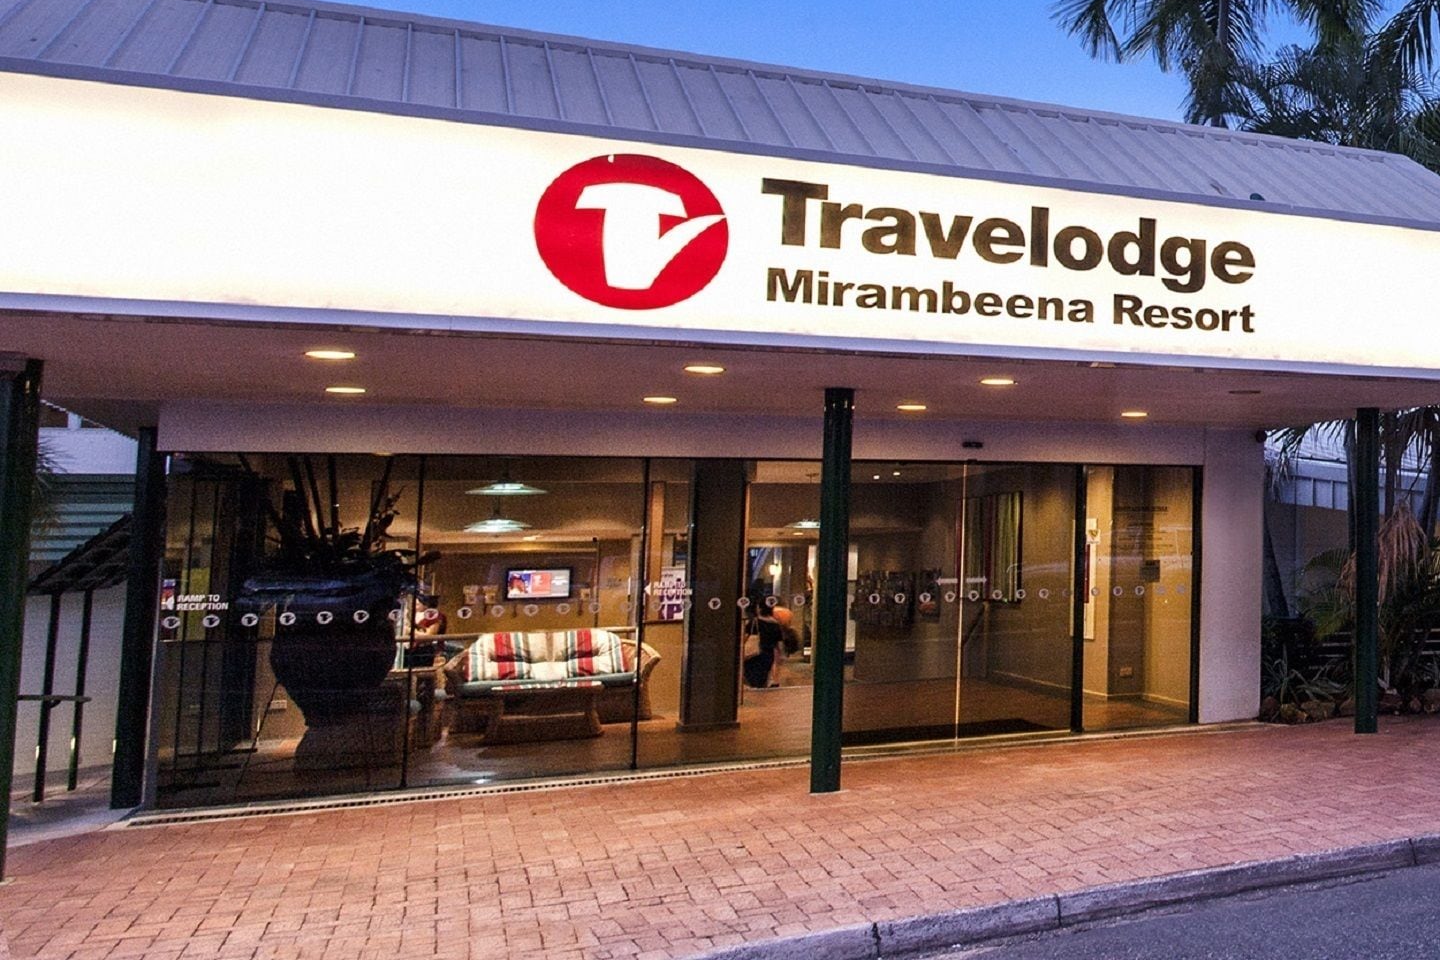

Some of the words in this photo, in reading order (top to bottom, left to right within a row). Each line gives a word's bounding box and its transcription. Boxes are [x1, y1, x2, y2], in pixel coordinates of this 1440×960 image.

[761, 177, 1257, 294] Travelodge
[766, 267, 1094, 323] Mirambeena
[1113, 293, 1255, 334] Resort
[176, 602, 229, 611] RECEPTION
[177, 594, 206, 603] RAMP
[208, 594, 220, 602] TO
